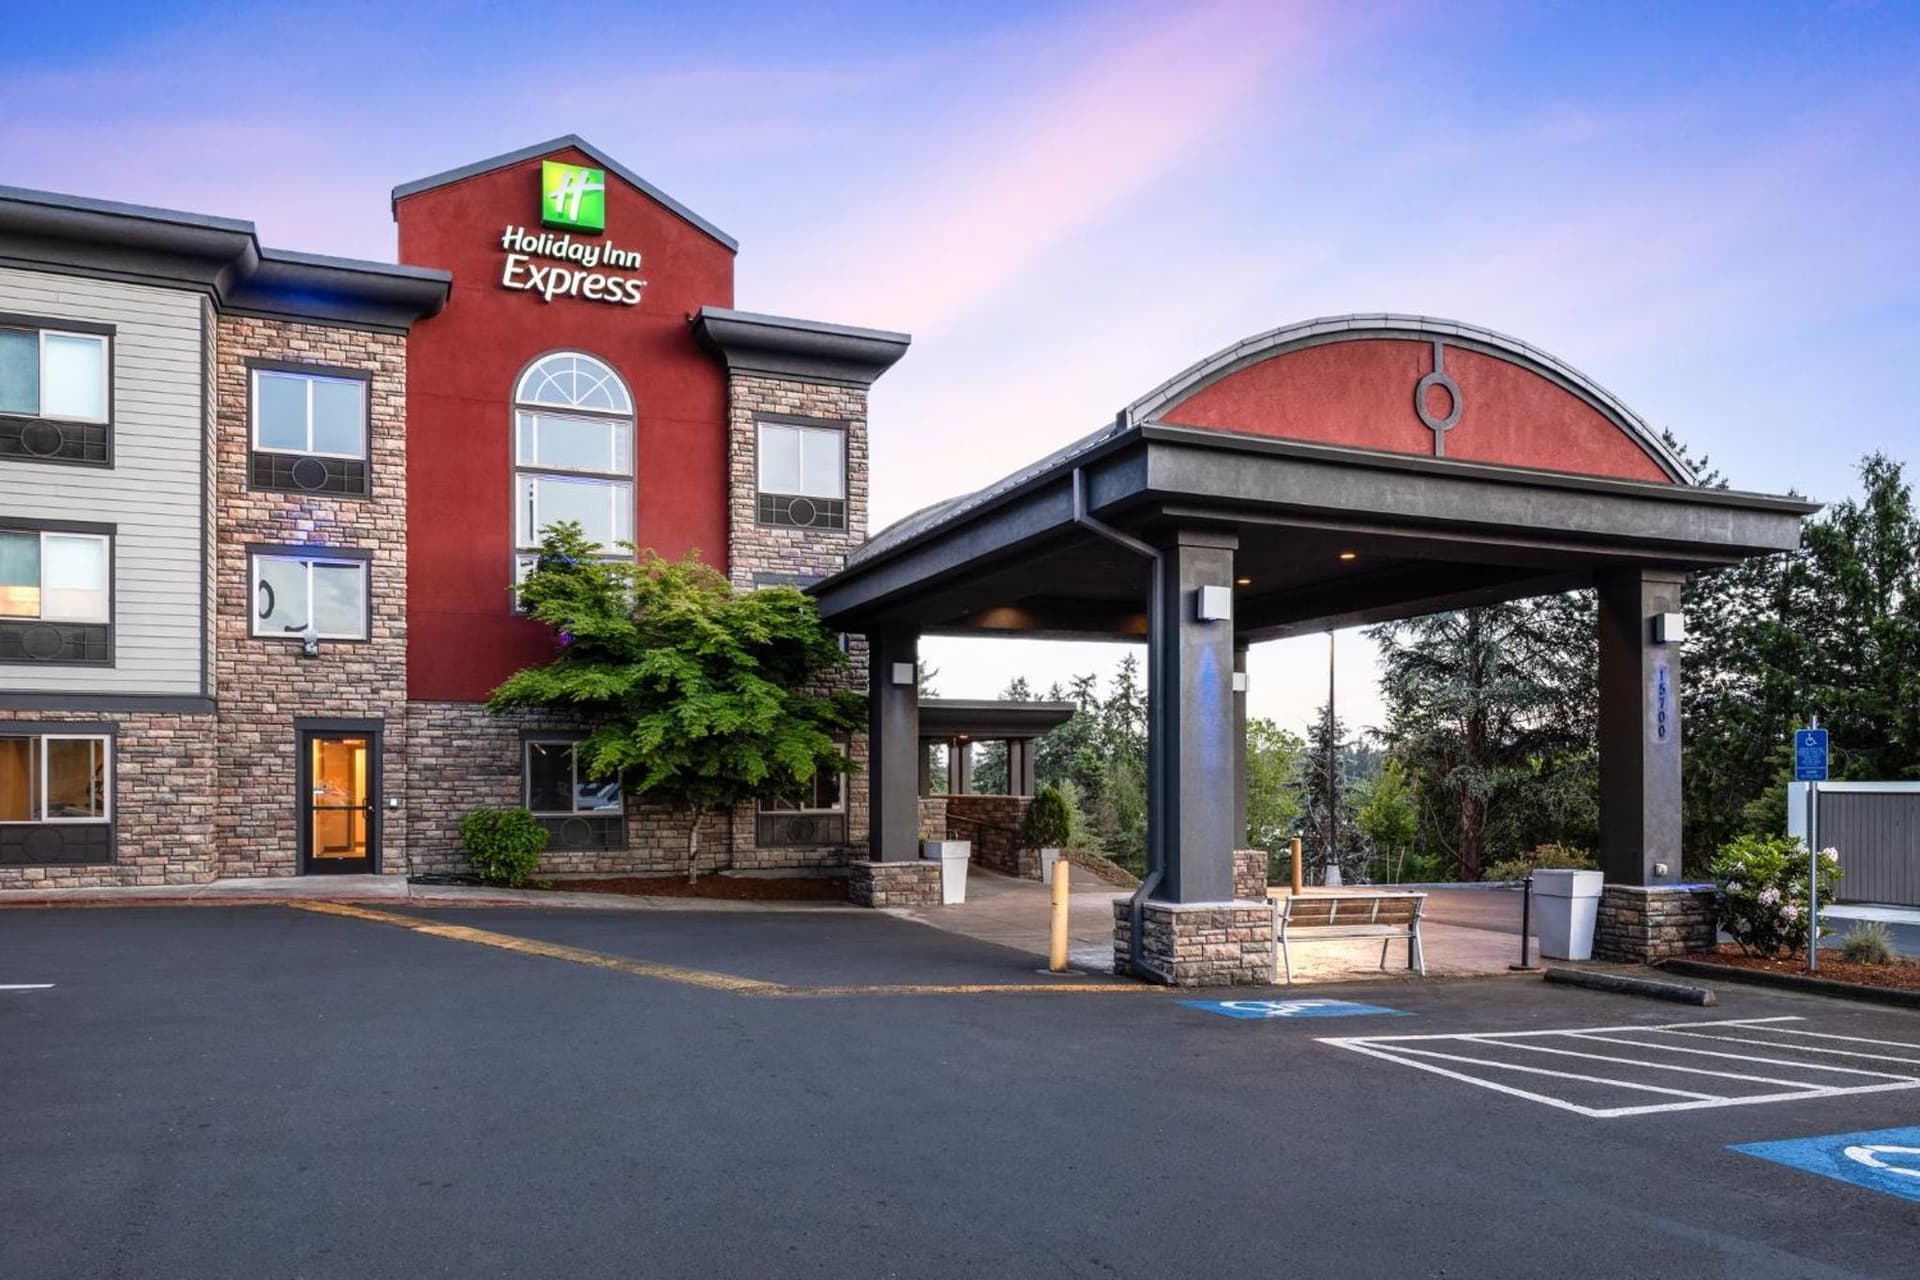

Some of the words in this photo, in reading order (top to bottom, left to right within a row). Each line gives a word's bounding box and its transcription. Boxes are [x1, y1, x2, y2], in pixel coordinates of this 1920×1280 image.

[502, 225, 600, 267] Holiday
[603, 240, 642, 269] Inn
[502, 253, 643, 305] Express
[1657, 668, 1667, 738] 15700
